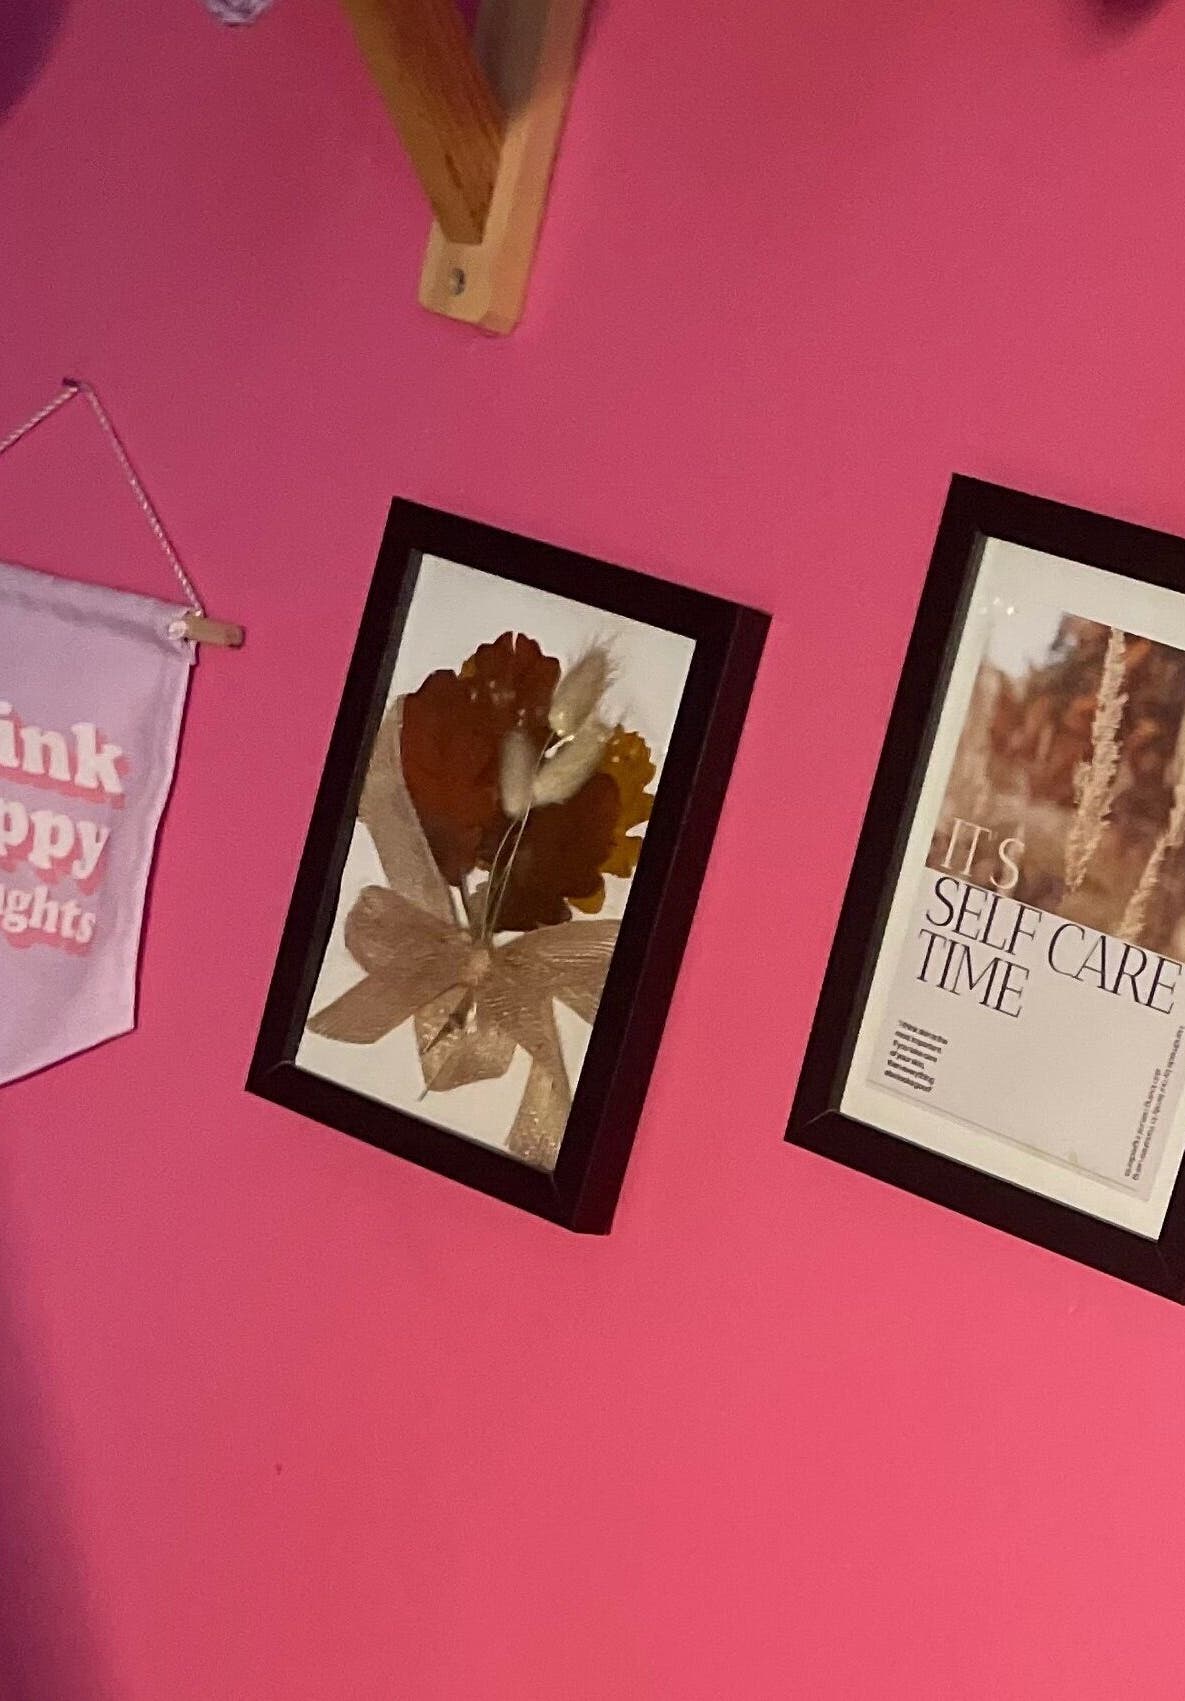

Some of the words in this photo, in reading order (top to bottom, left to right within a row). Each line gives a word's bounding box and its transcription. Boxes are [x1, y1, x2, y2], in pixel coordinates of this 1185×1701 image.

[0, 883, 97, 944] ghts
[926, 876, 1042, 956] SELF
[1047, 922, 1183, 1015] CARE
[916, 928, 1030, 1018] TIME
